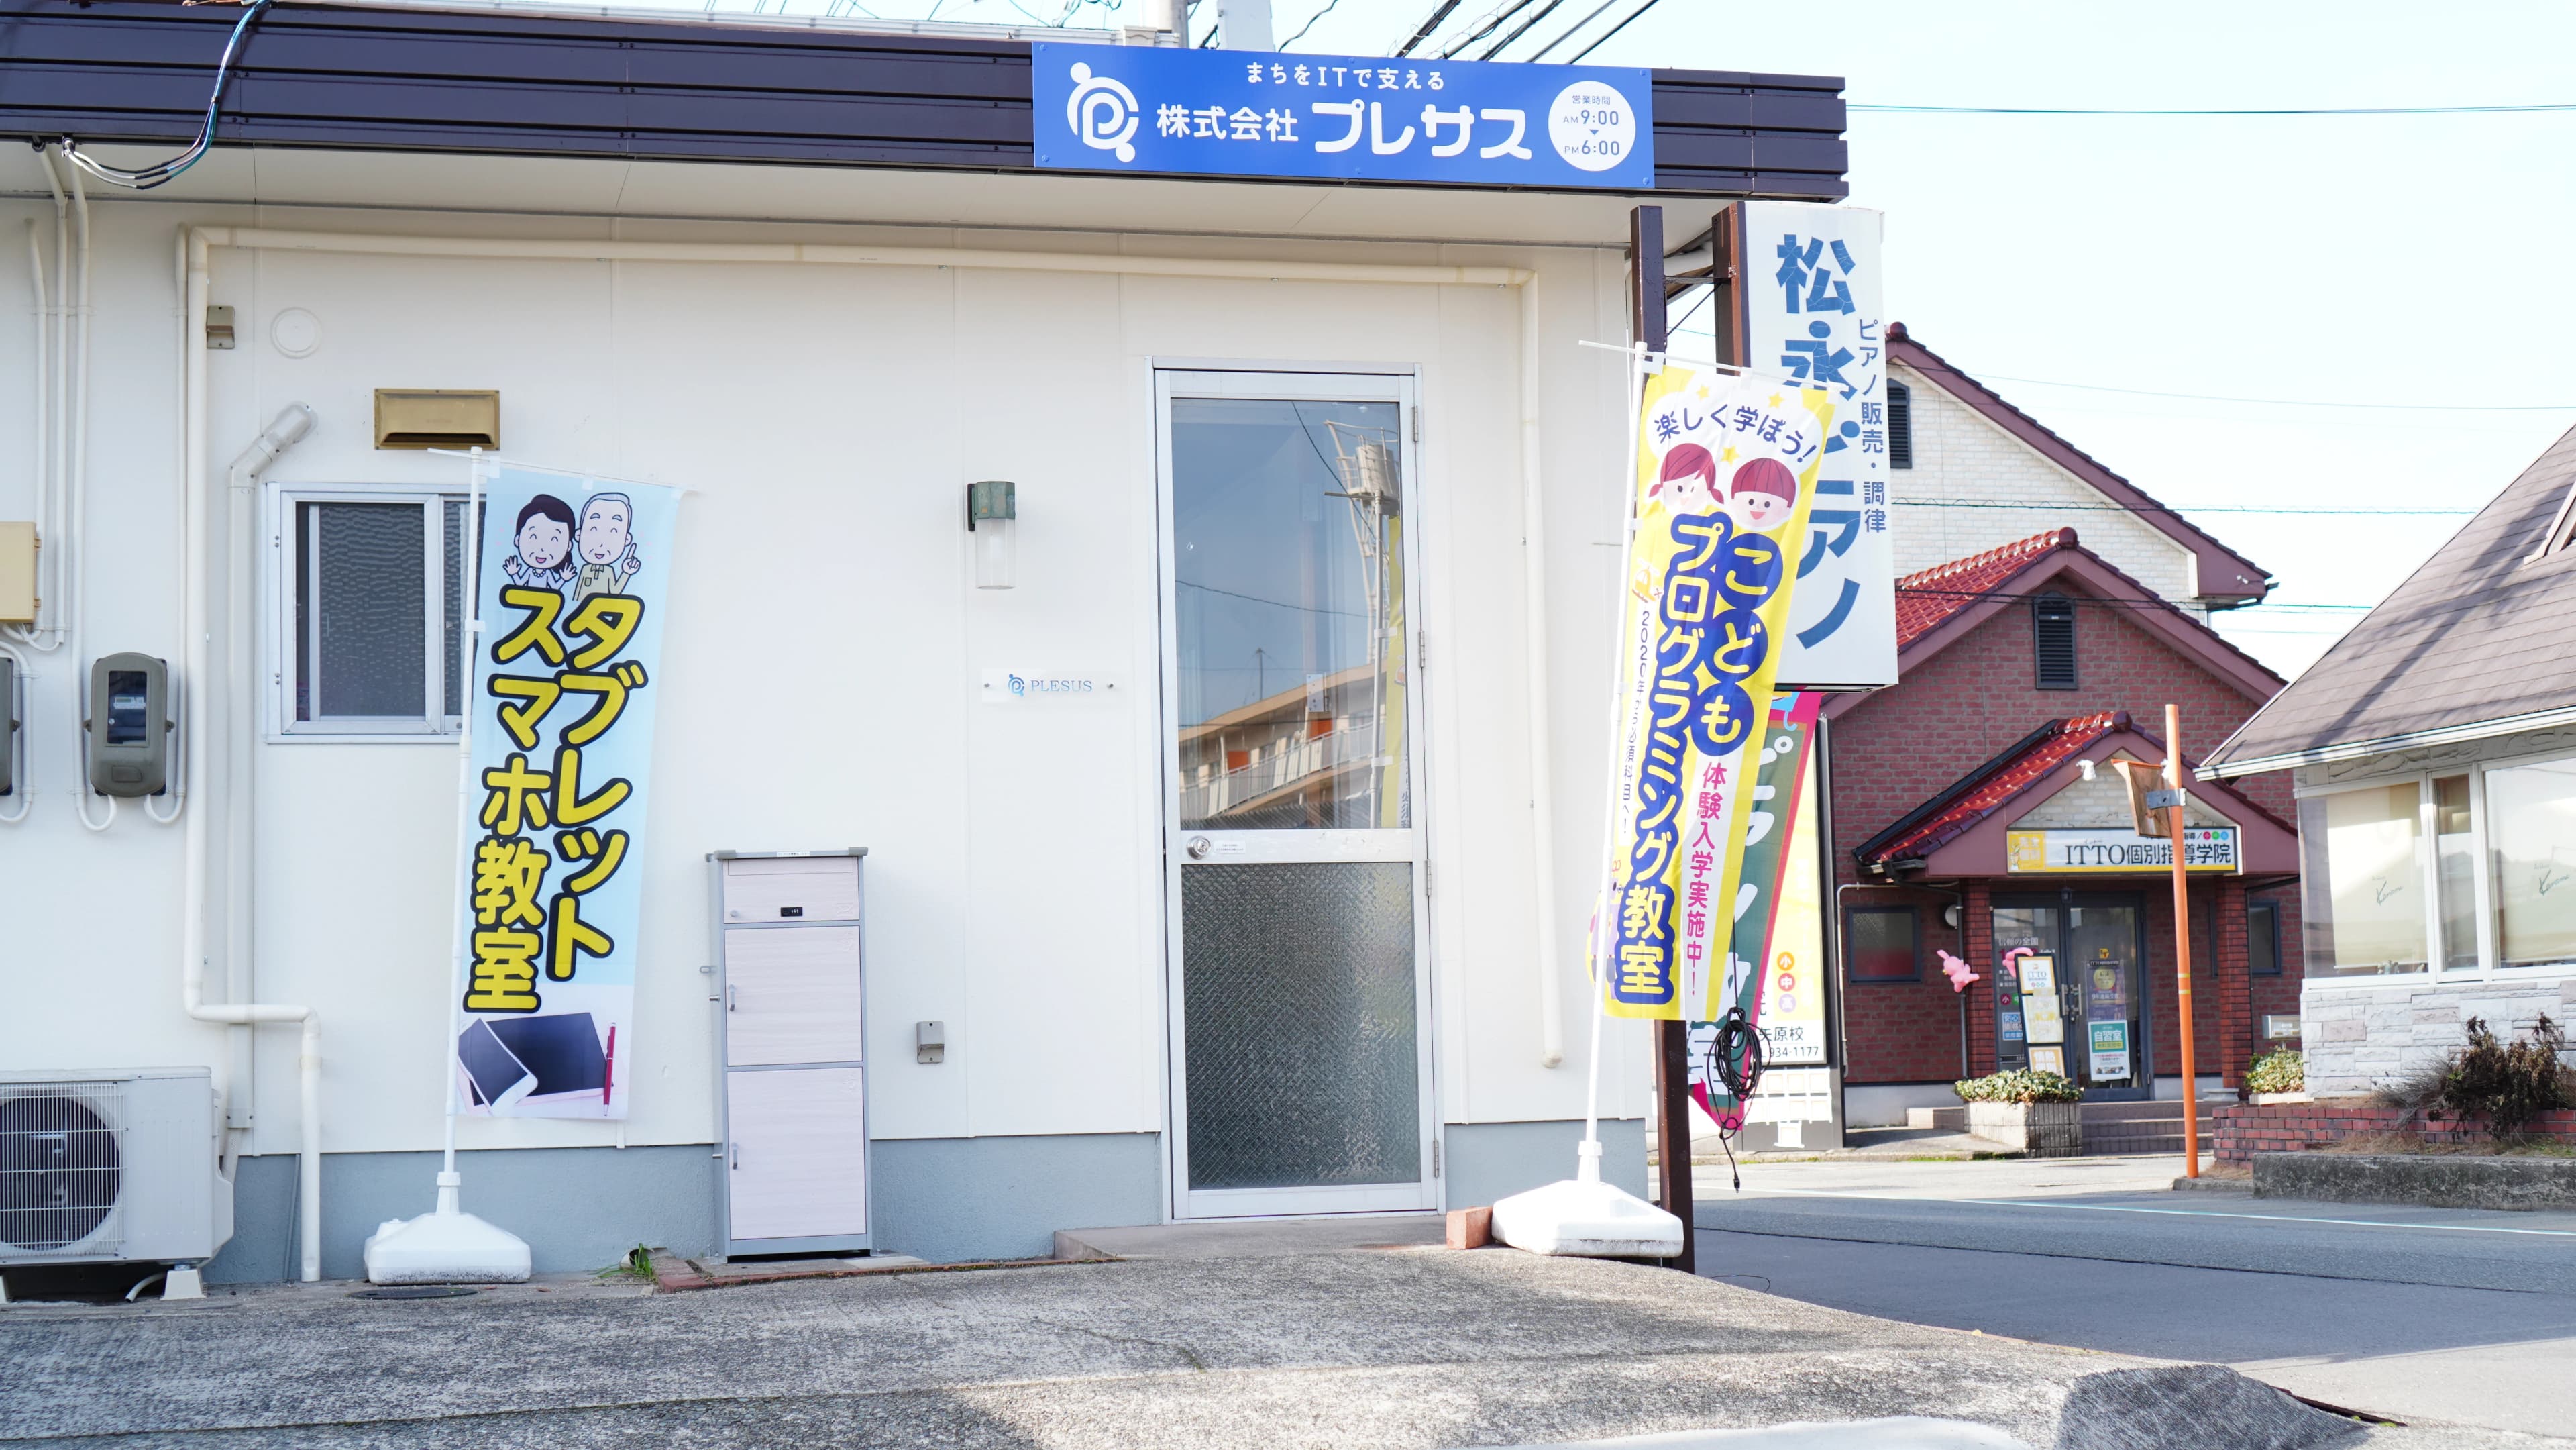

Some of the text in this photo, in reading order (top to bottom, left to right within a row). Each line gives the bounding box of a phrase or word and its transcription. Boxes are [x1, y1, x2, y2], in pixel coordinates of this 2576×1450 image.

[1246, 61, 1444, 91] まちをITで支える
[1572, 95, 1611, 105] 営業時間
[1156, 98, 1533, 160] 株式会社 プレサス
[1563, 109, 1619, 126] AM 9:00
[1564, 139, 1620, 156] PM 6:00
[1654, 403, 1817, 464] 楽しく学ぼう！
[1858, 318, 1887, 534] ピアノ販売・調律
[1699, 546, 1774, 744] こども
[1030, 680, 1093, 692] PLESUS
[550, 594, 647, 980] タブレット
[1619, 521, 1726, 996] プログラミング教室
[465, 586, 566, 1011] スマホ教室
[1686, 762, 1728, 996] 体験入学実施中！
